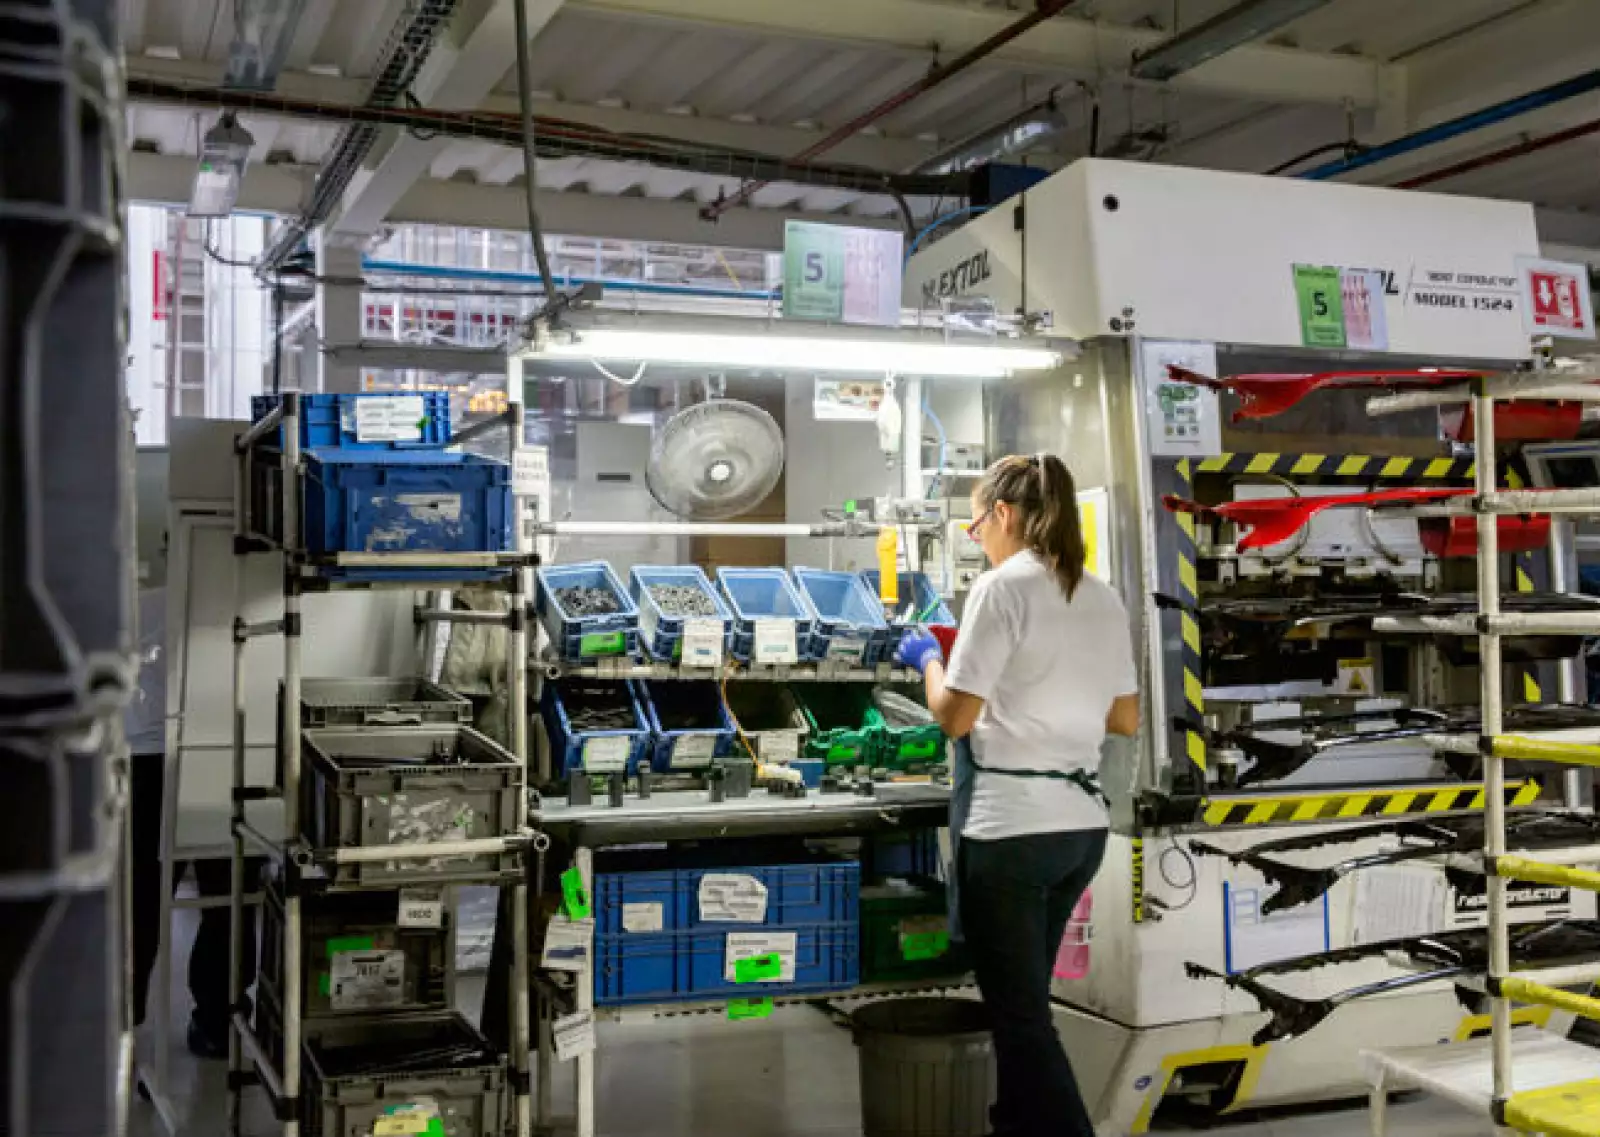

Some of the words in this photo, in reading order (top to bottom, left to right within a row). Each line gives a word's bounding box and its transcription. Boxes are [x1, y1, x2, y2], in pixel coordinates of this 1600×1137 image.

[805, 253, 823, 283] 5
[1313, 290, 1328, 316] 5
[1414, 292, 1466, 309] MODEL
[1472, 297, 1513, 311] 1524
